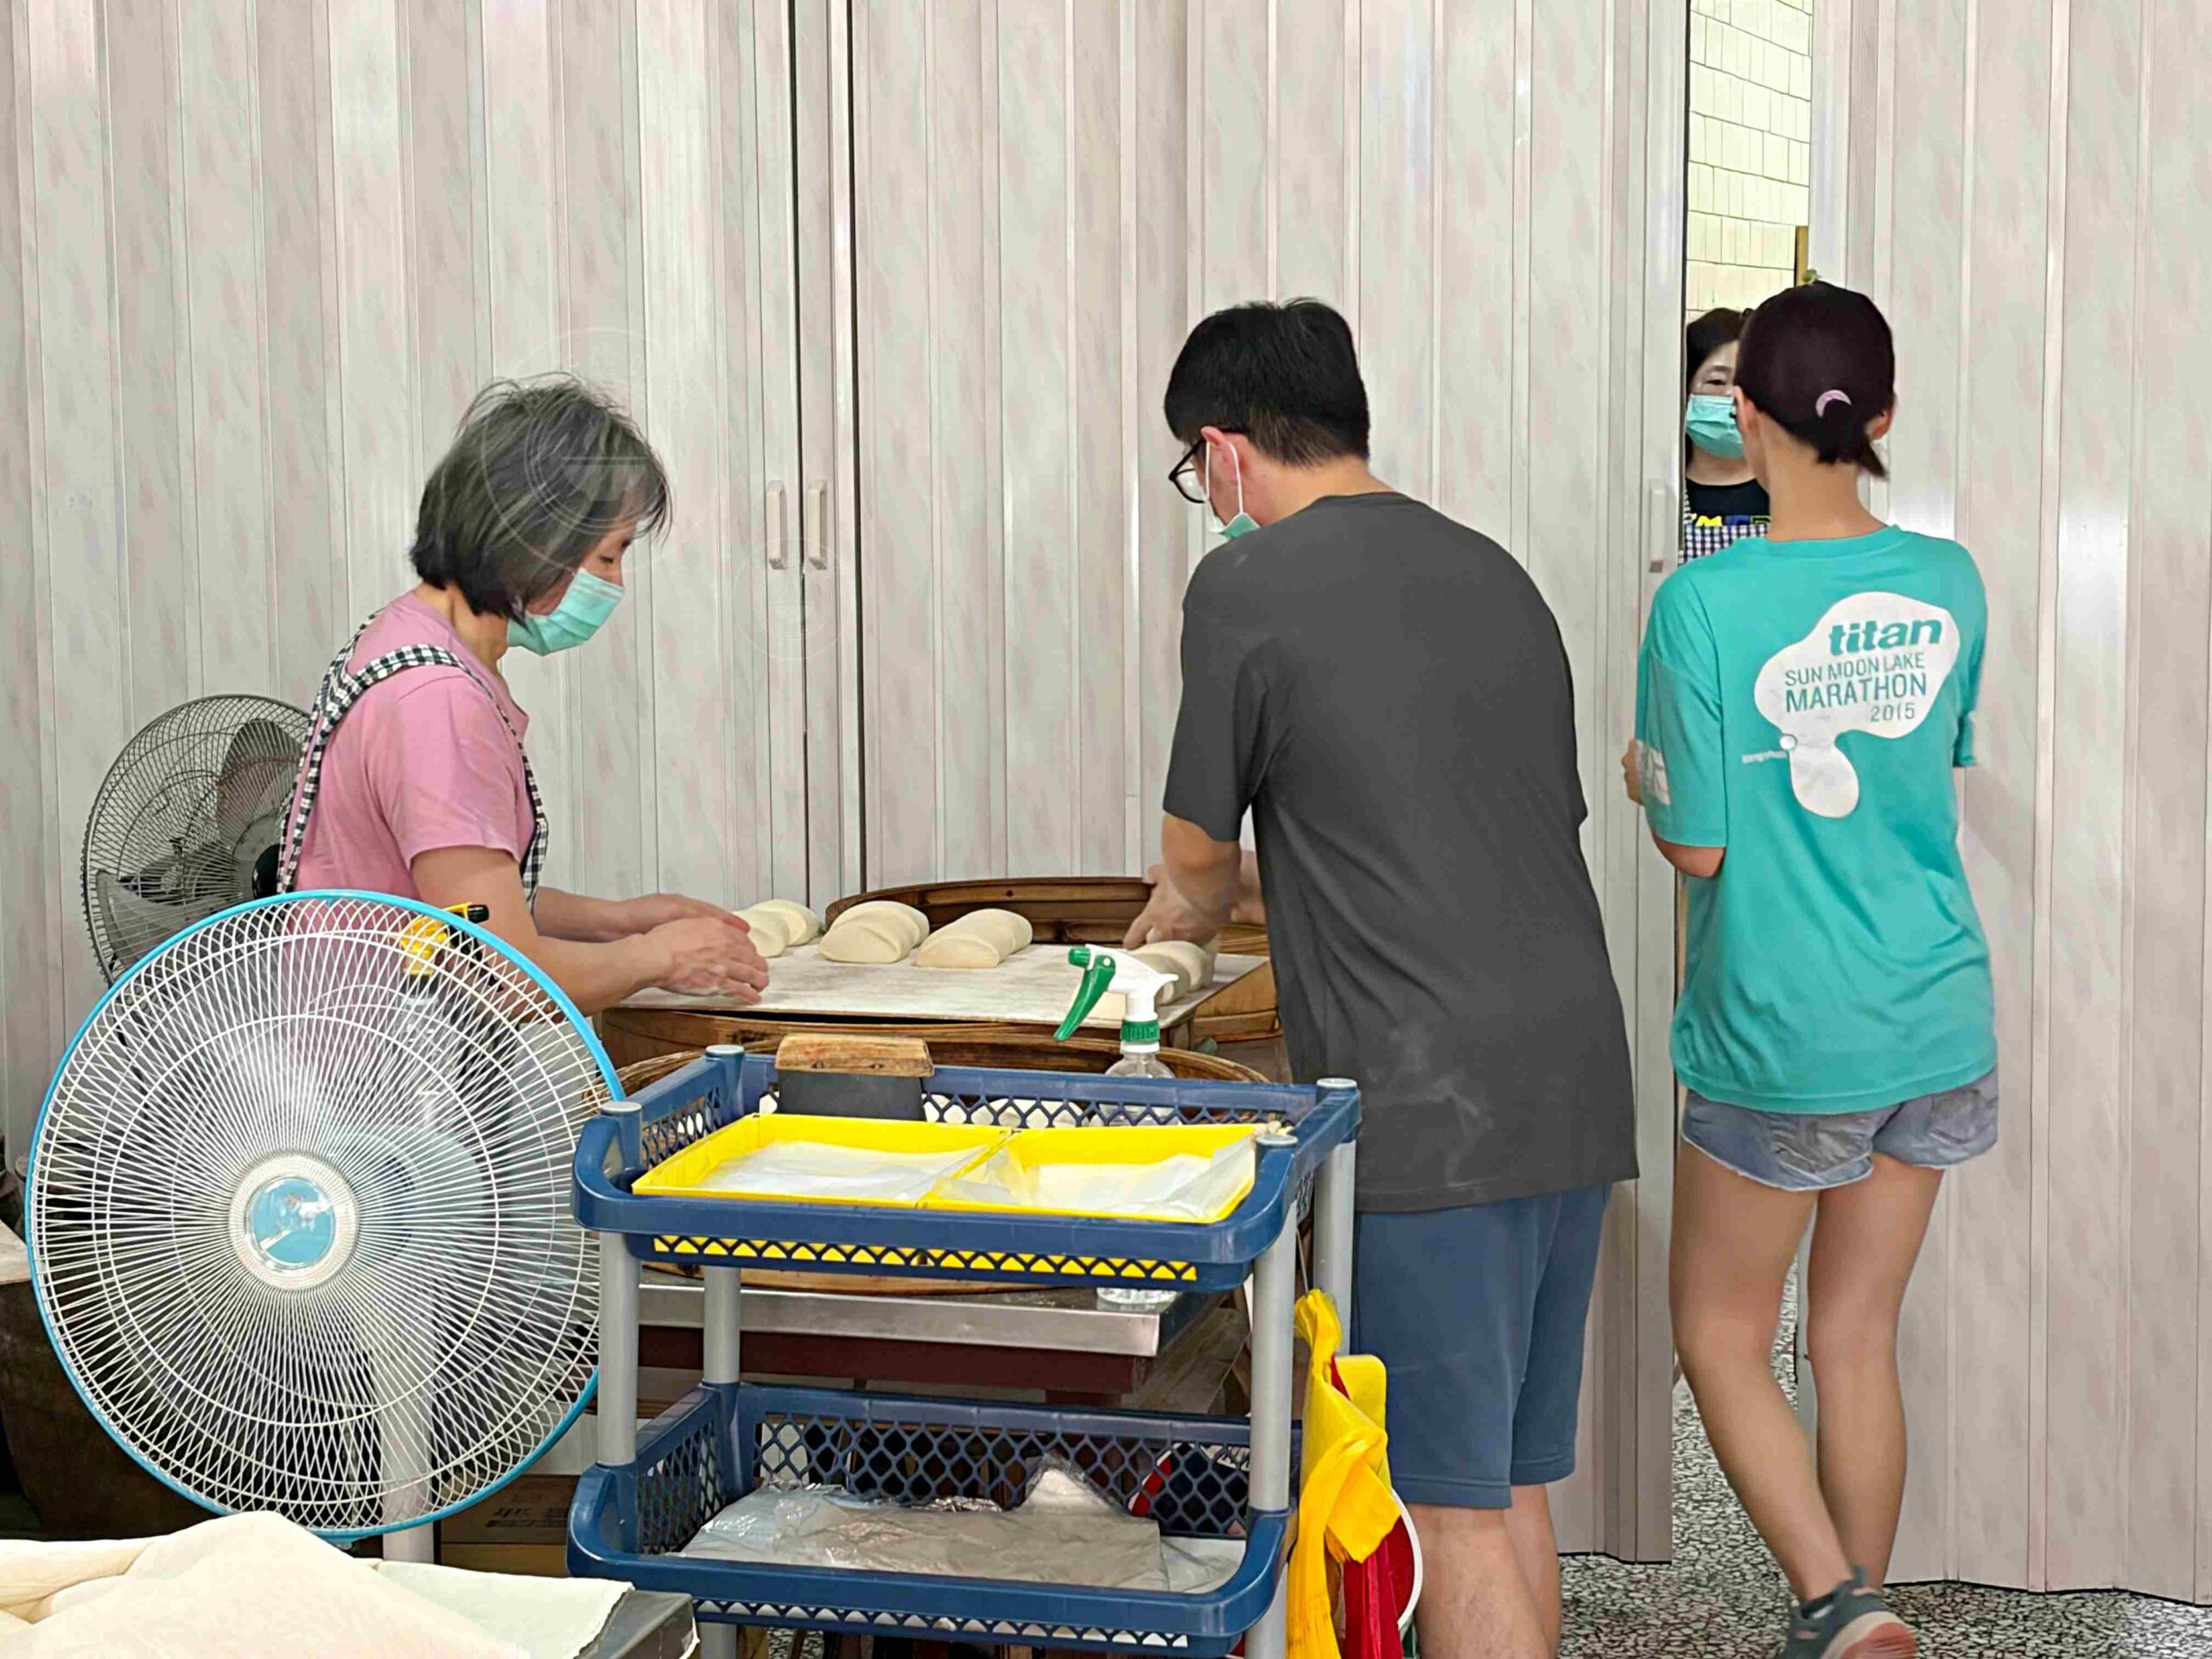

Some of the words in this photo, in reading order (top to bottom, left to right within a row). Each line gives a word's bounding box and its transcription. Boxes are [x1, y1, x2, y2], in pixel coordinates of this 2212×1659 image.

[1828, 619, 1942, 656] titan
[1784, 665, 1823, 687] SUN
[1827, 657, 1879, 680] MOON
[1883, 652, 1926, 671] LAKE
[1785, 672, 1927, 713] MARATHON
[1870, 702, 1916, 722] 2015
